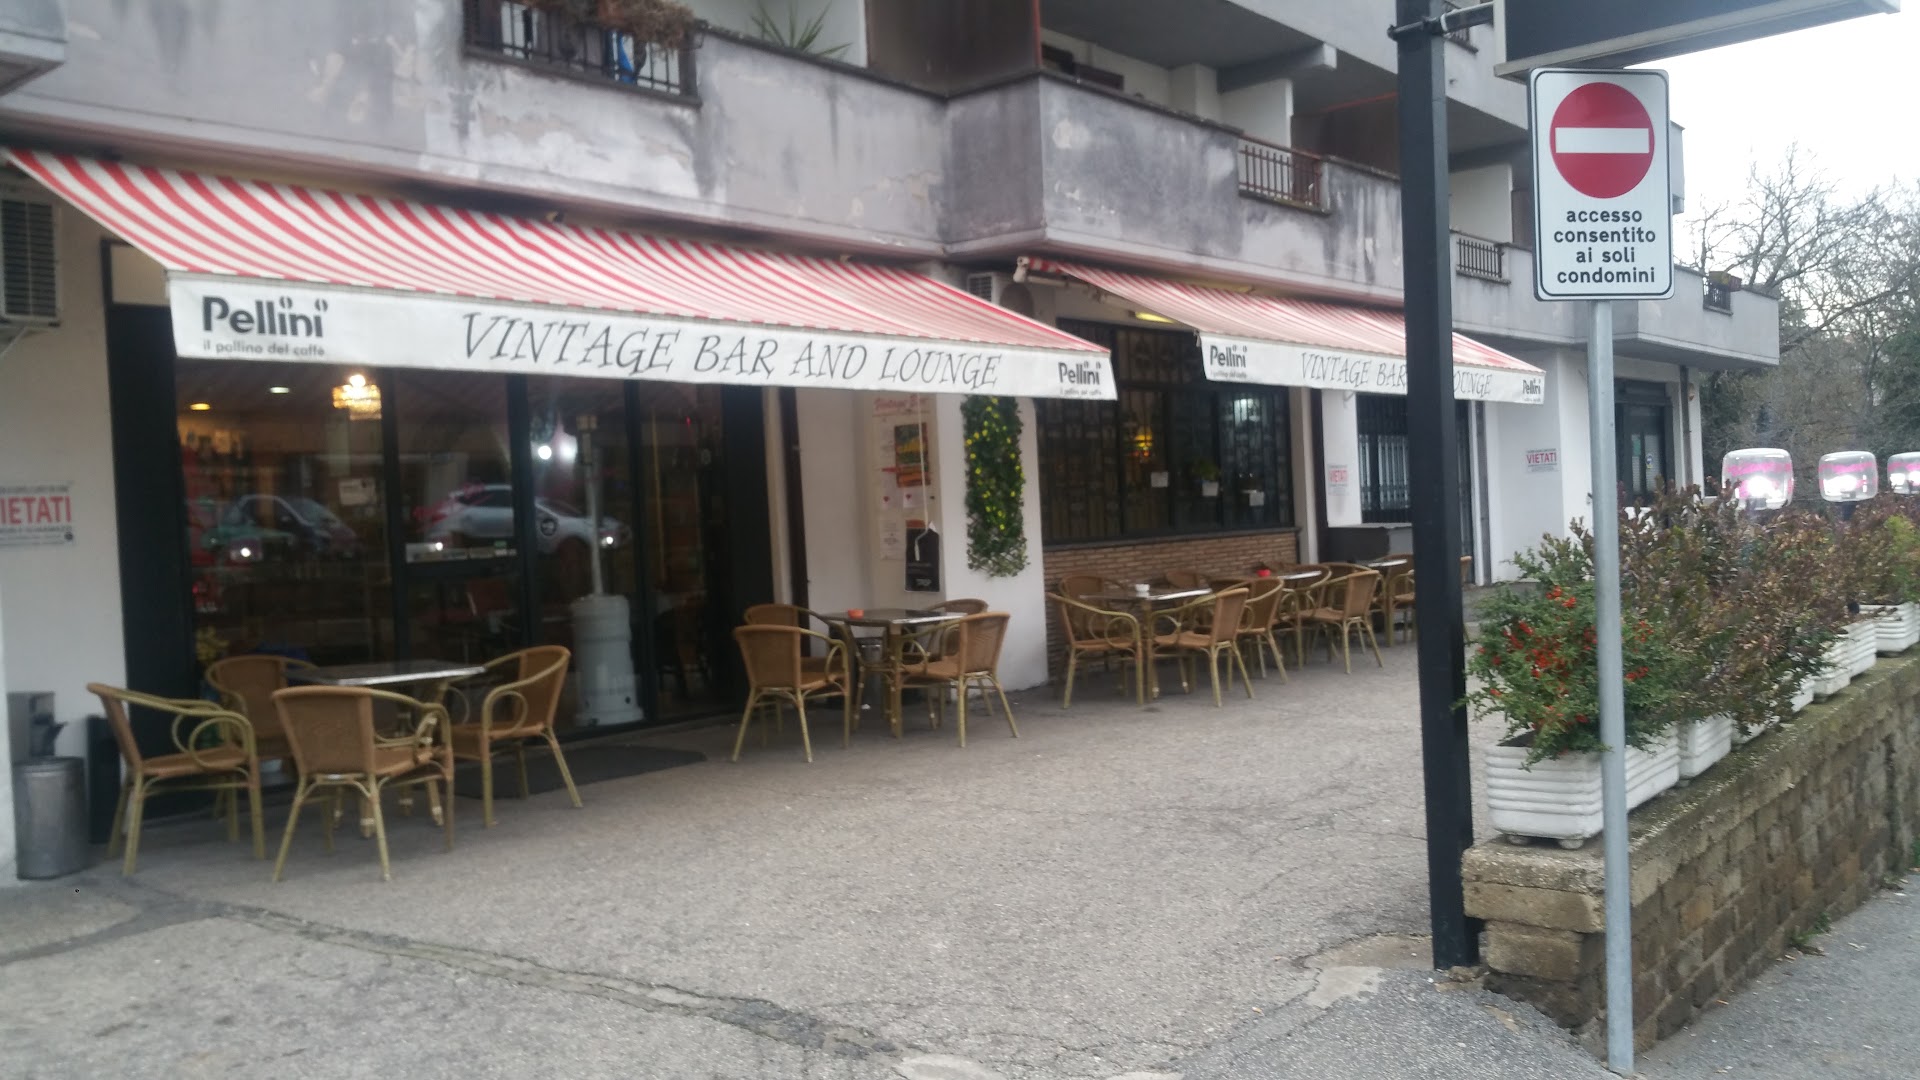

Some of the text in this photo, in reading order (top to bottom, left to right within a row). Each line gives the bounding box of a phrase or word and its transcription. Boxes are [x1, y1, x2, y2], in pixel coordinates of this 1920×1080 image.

[1566, 210, 1643, 223] accesso
[1553, 226, 1656, 244] consentito
[1575, 247, 1635, 264] ai soli
[1556, 267, 1655, 284] condomini
[202, 296, 328, 338] Pellini
[463, 312, 1003, 391] VINTAGE BAR AND LOUNGE
[1210, 344, 1248, 369] Pellini
[1058, 360, 1102, 386] Pellini
[1301, 352, 1492, 398] VINTAGE BAR OUNGE
[1526, 452, 1557, 464] VIETATI
[0, 496, 72, 525] IETATI
